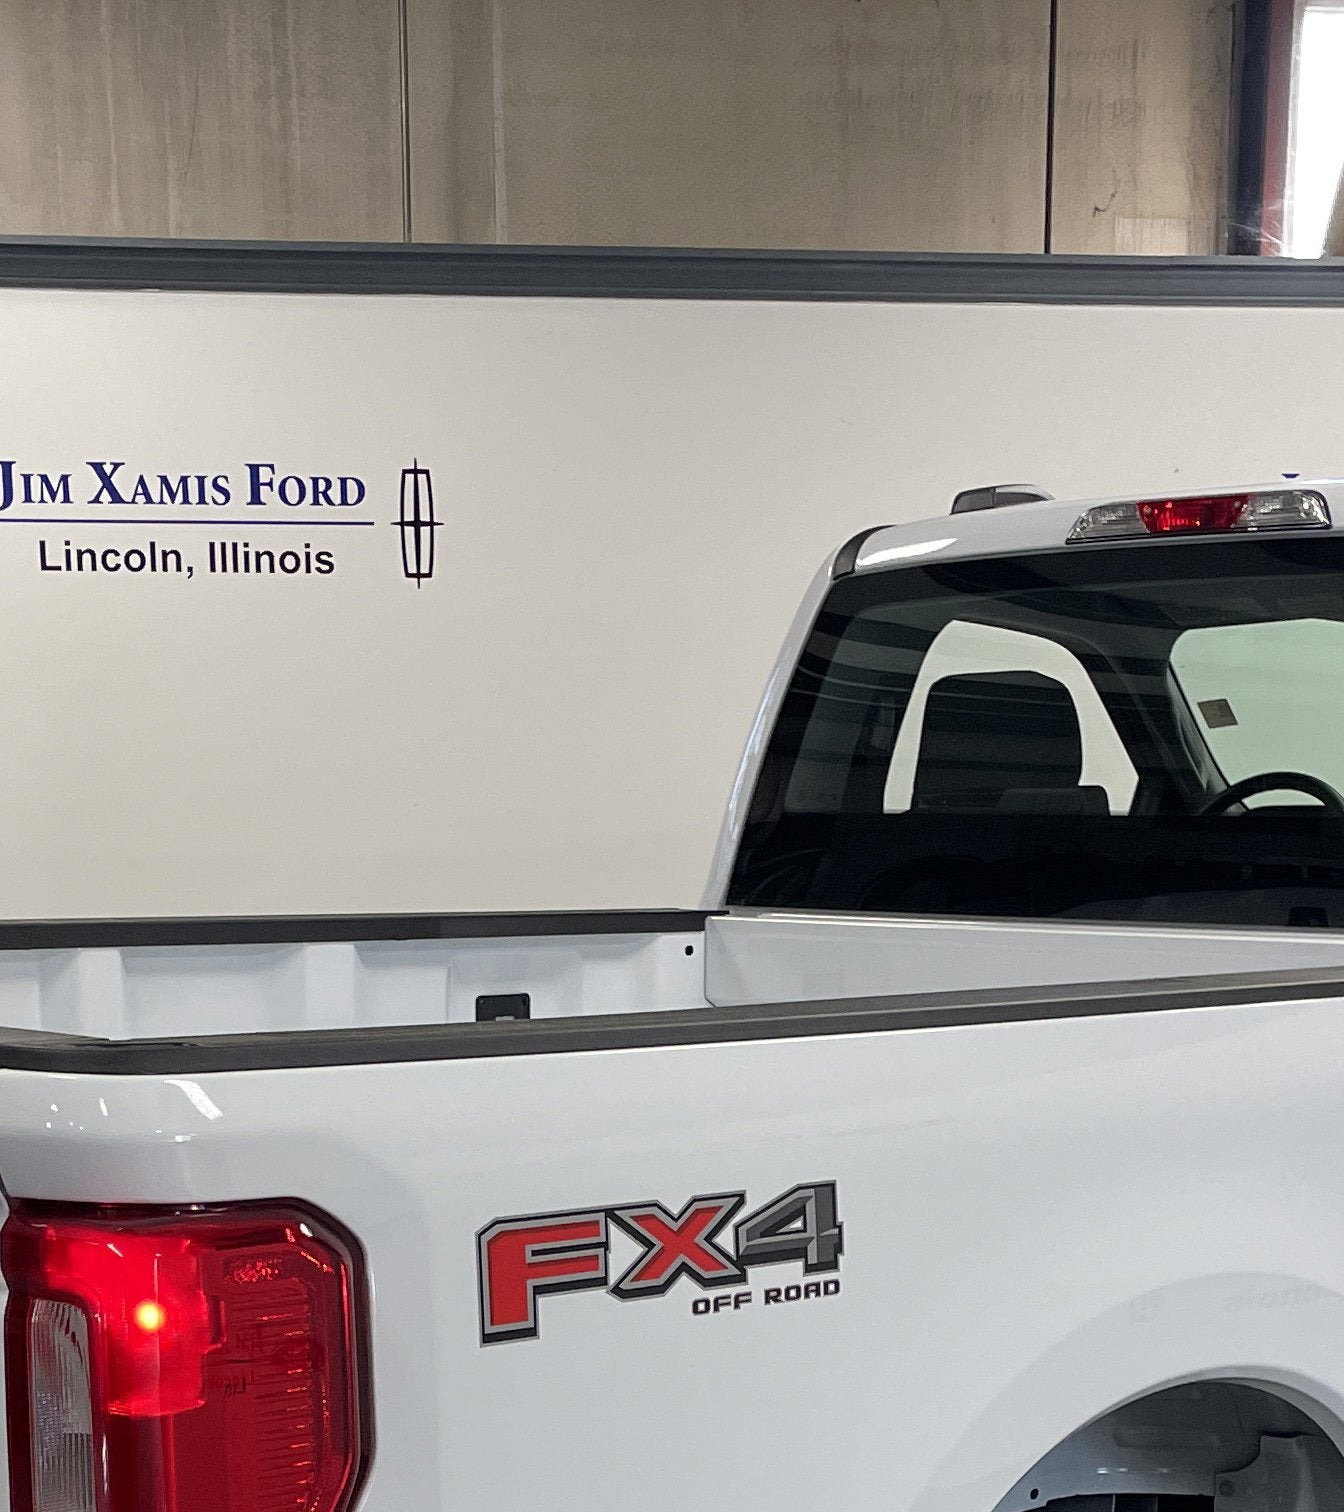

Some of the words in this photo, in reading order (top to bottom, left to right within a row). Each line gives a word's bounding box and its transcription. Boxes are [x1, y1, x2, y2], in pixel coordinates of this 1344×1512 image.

[85, 461, 231, 507] XAMIS
[244, 462, 366, 507] FORD
[38, 541, 194, 579] Lincoln,
[207, 541, 335, 575] Illinois
[475, 1180, 844, 1348] FX4
[692, 1291, 753, 1316] OFF
[764, 1279, 841, 1305] ROAD
